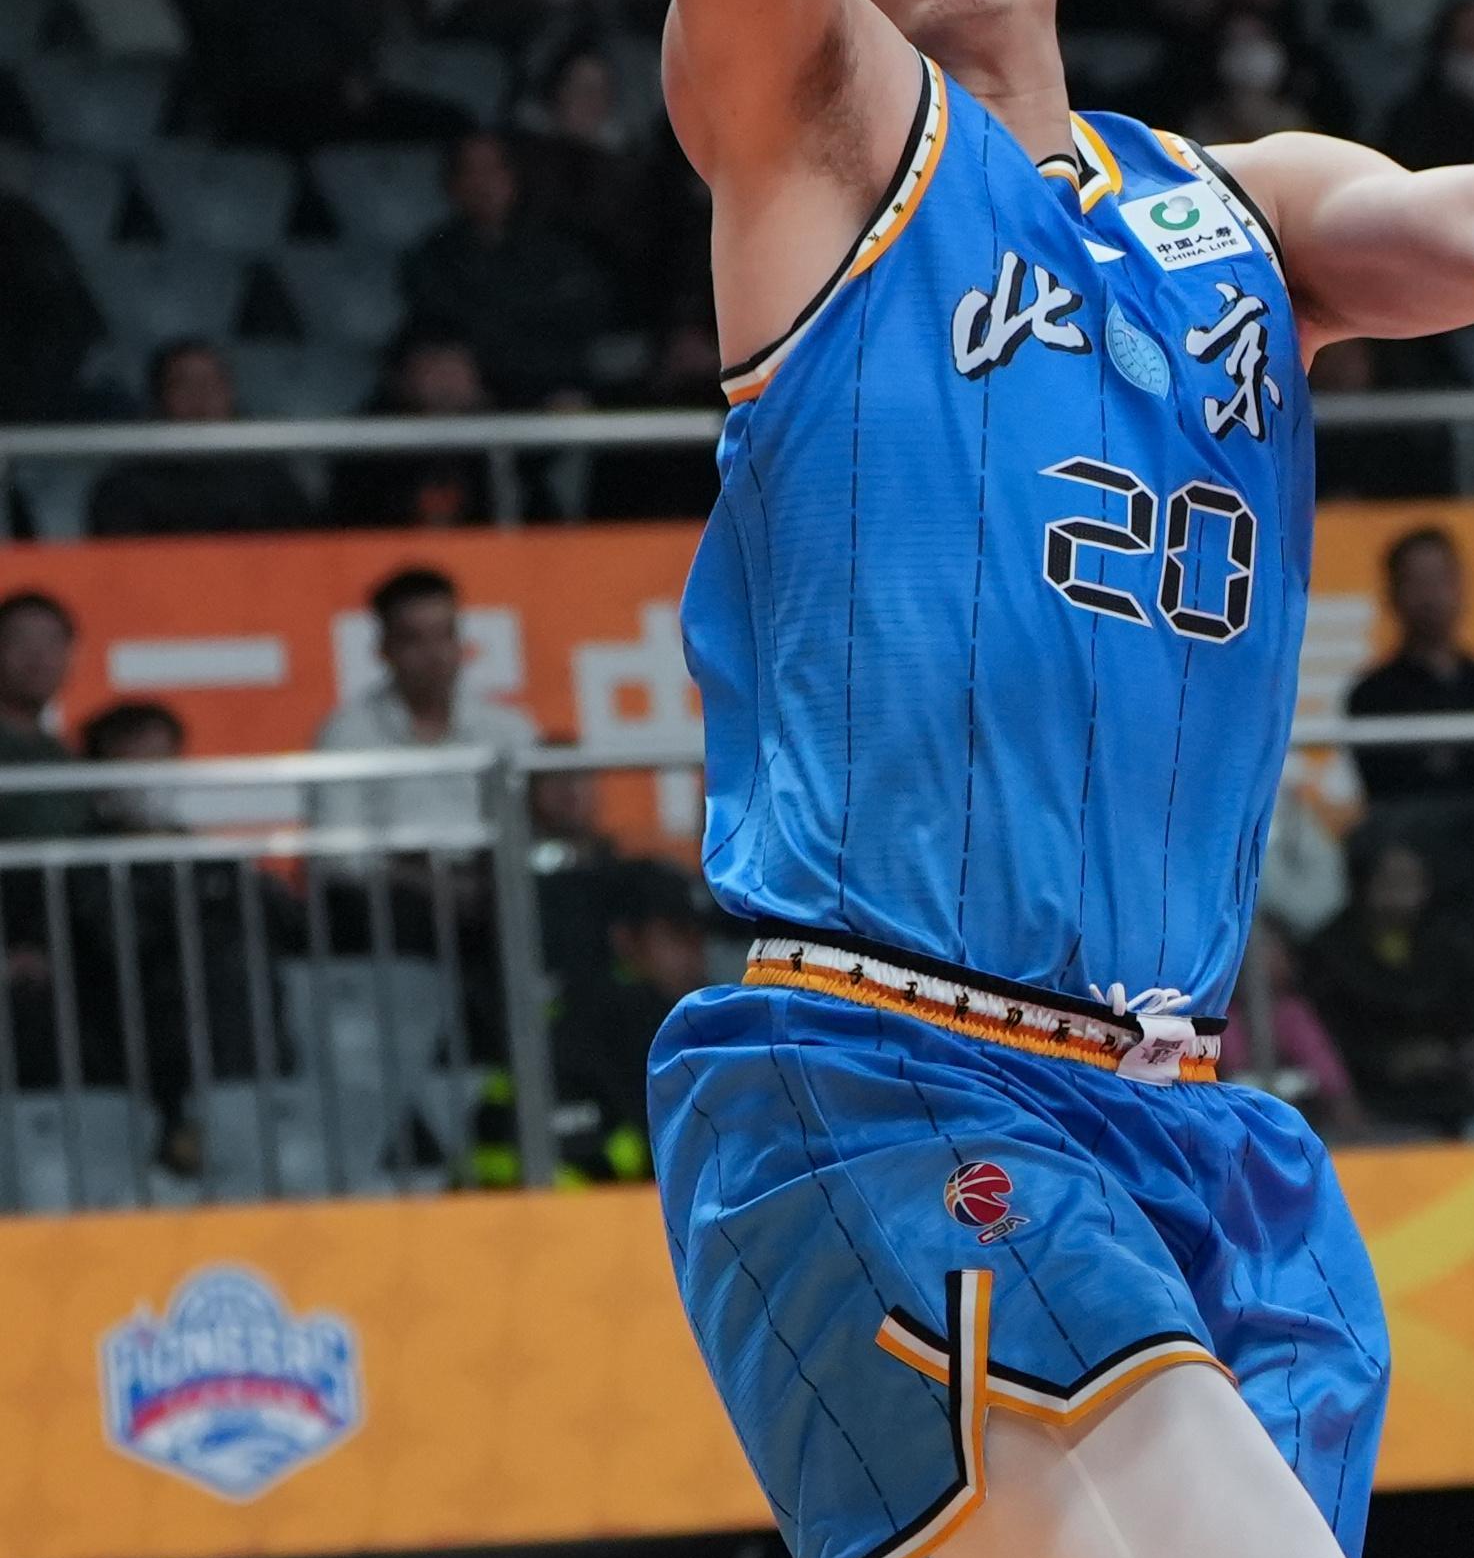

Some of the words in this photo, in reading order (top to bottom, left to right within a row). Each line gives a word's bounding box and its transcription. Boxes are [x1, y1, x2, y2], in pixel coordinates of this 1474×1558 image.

[1156, 226, 1232, 254] 中国人寿
[1163, 247, 1206, 263] CHINA
[1209, 238, 1239, 253] LIFE
[1037, 456, 1257, 644] 20
